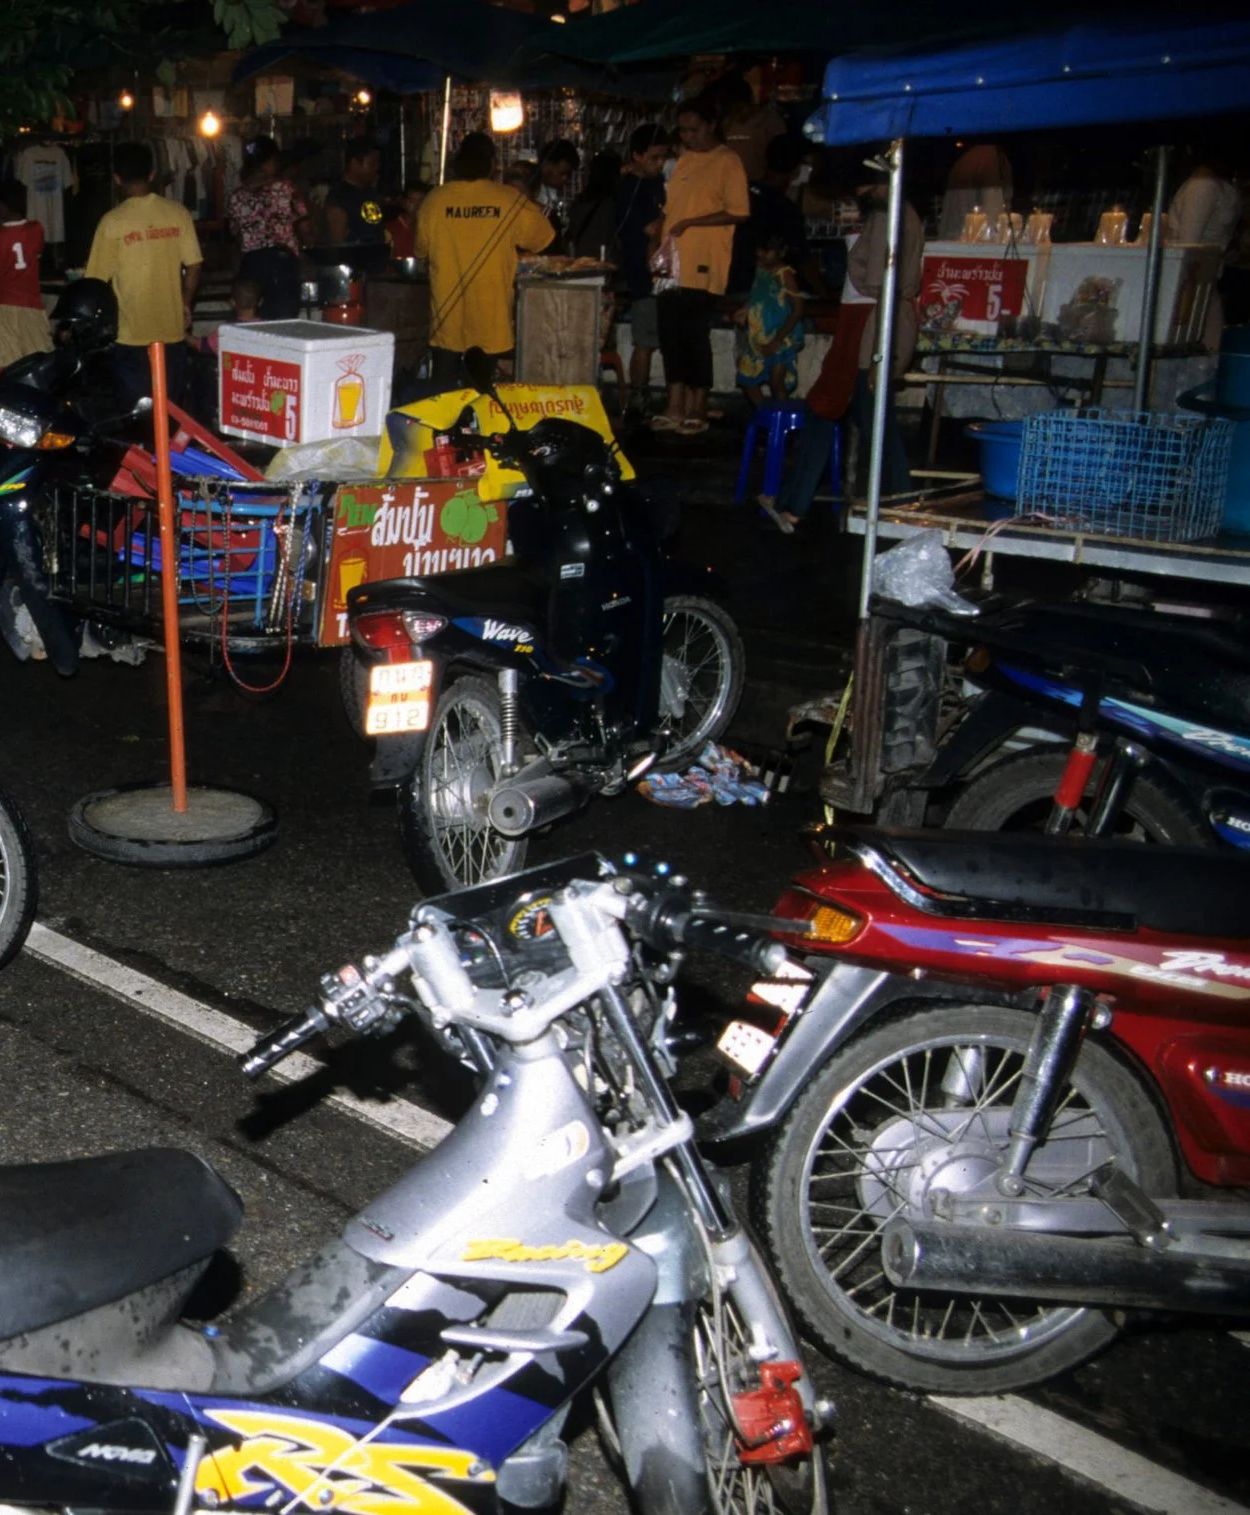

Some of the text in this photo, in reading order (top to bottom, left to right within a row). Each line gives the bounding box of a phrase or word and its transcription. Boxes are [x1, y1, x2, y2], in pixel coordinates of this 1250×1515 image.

[445, 206, 500, 219] MAUREEN
[12, 242, 27, 270] 1
[285, 395, 297, 440] 5
[482, 619, 535, 643] Wave
[514, 644, 535, 653] 110
[77, 1443, 156, 1464] NOVA
